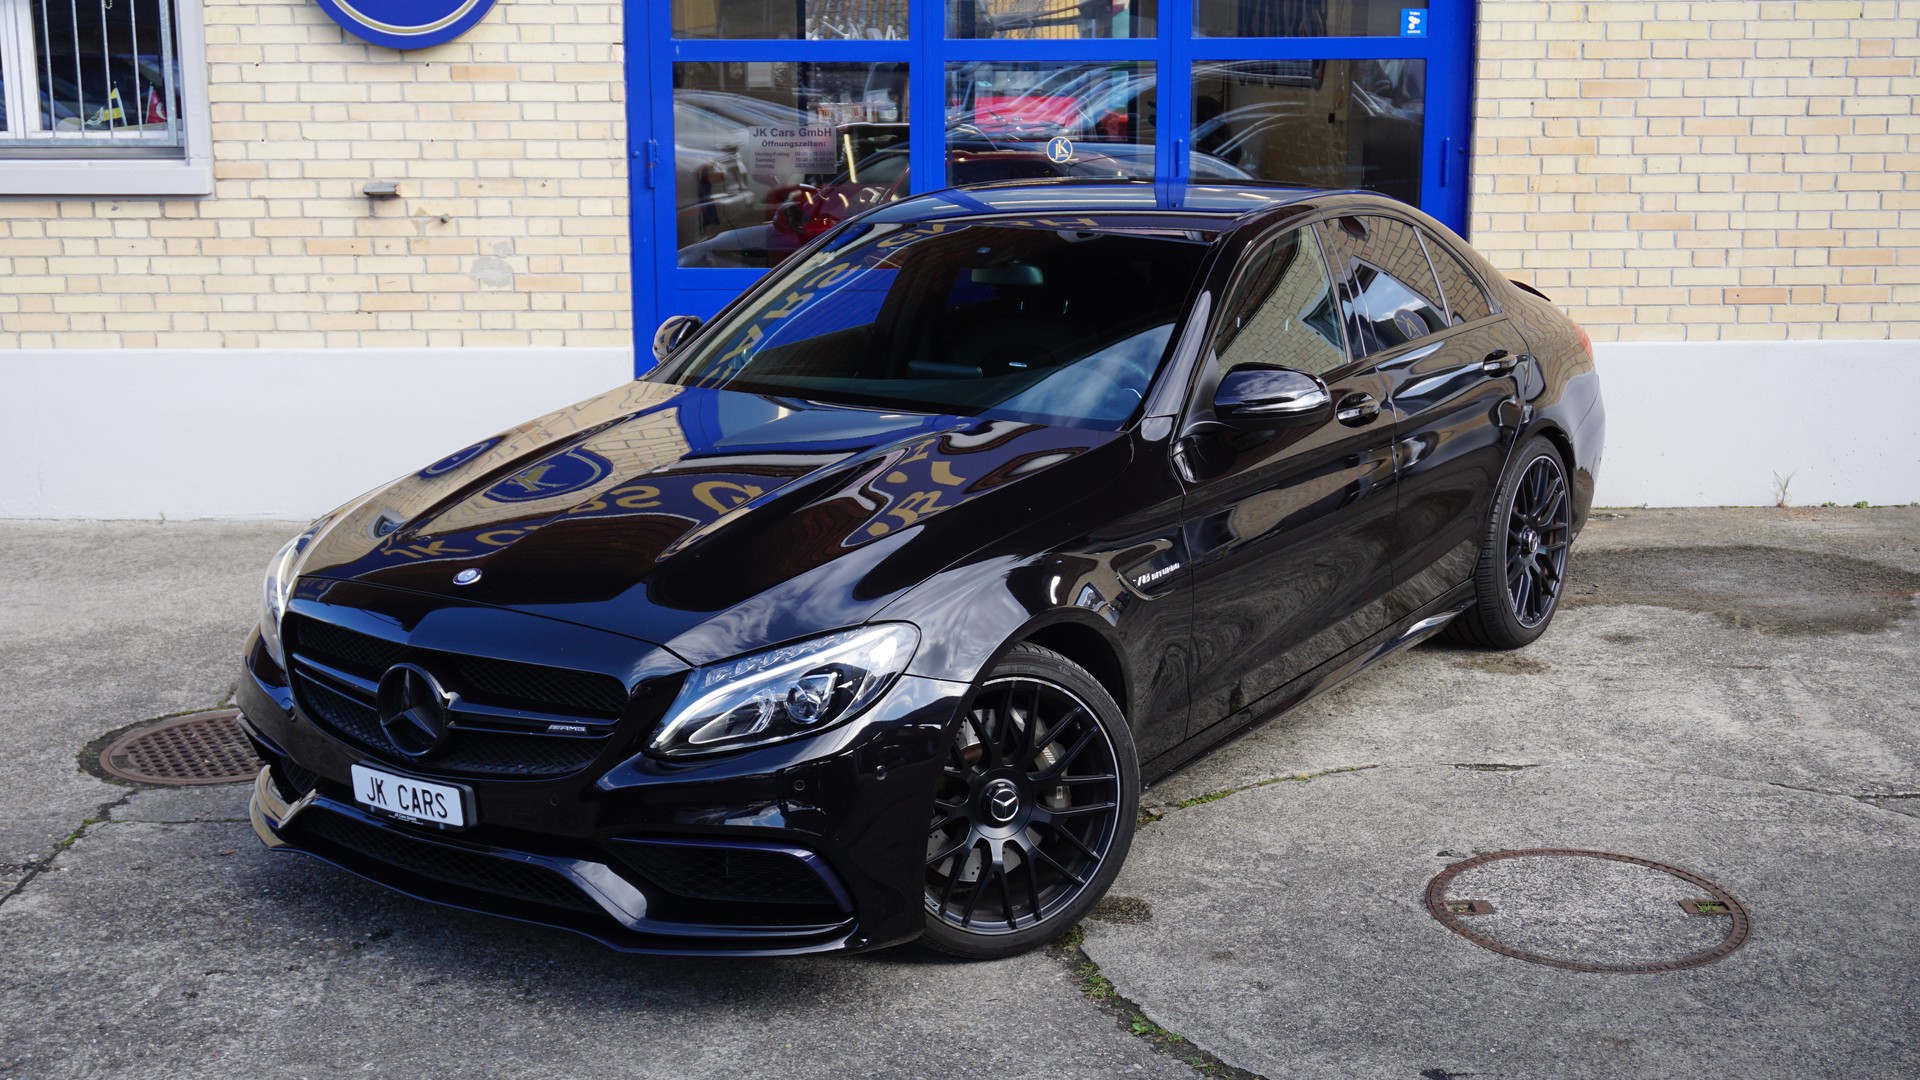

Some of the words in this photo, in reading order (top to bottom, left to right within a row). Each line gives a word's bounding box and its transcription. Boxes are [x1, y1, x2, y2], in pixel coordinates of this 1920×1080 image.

[753, 127, 768, 137] JK
[770, 127, 796, 137] Cars
[798, 127, 832, 137] GmbH
[761, 140, 826, 148] Öffnungszeiten:
[366, 776, 388, 806] JK
[397, 784, 448, 819] CARS
